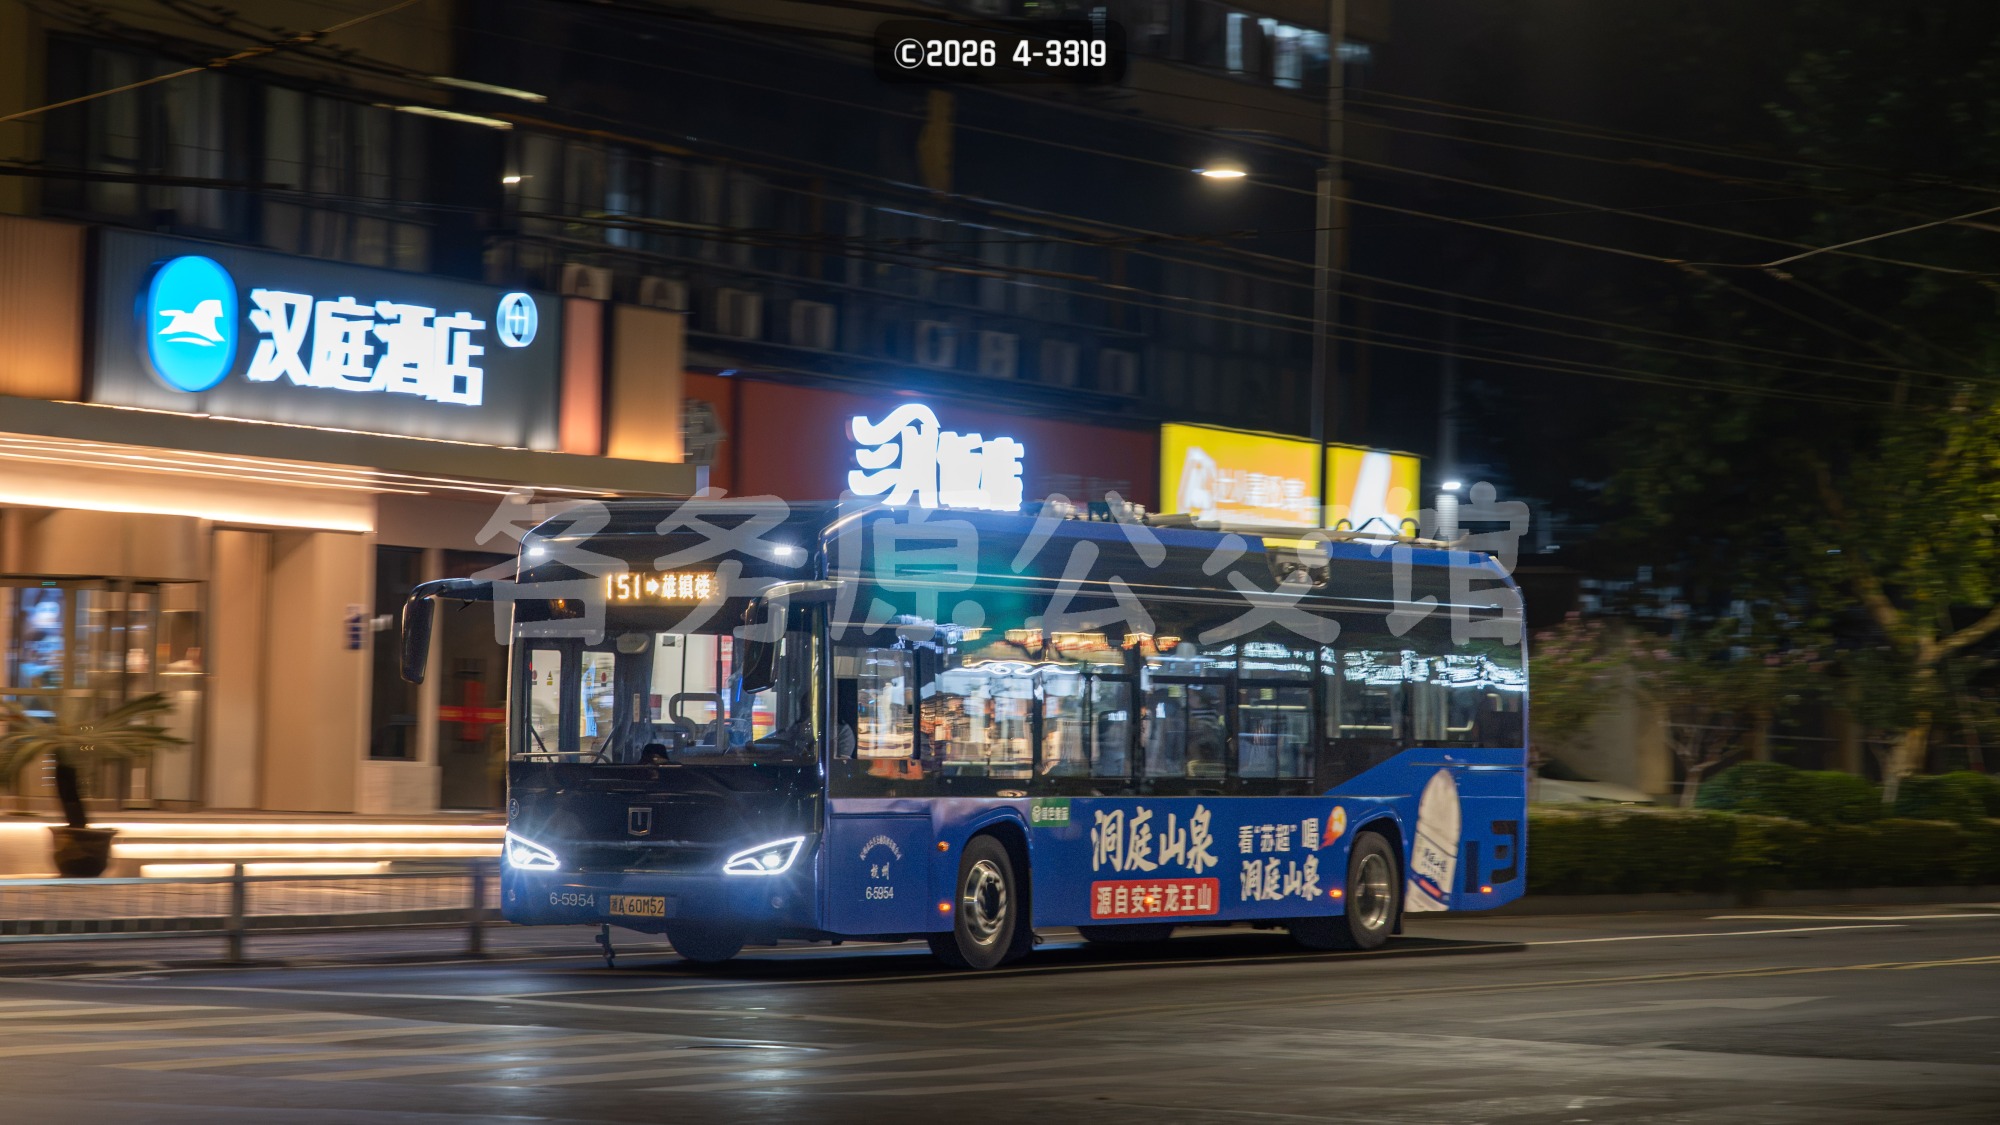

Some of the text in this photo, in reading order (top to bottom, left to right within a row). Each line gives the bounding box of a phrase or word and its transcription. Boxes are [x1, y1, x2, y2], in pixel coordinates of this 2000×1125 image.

[246, 288, 487, 406] 汉庭酒店
[606, 574, 641, 600] 151
[1091, 804, 1219, 875] 洞庭山泉
[865, 886, 895, 900] 6-5954
[1240, 854, 1323, 902] 洞庭山泉
[549, 892, 595, 908] 6-5954
[1096, 883, 1213, 916] 源自安吉龙王山
